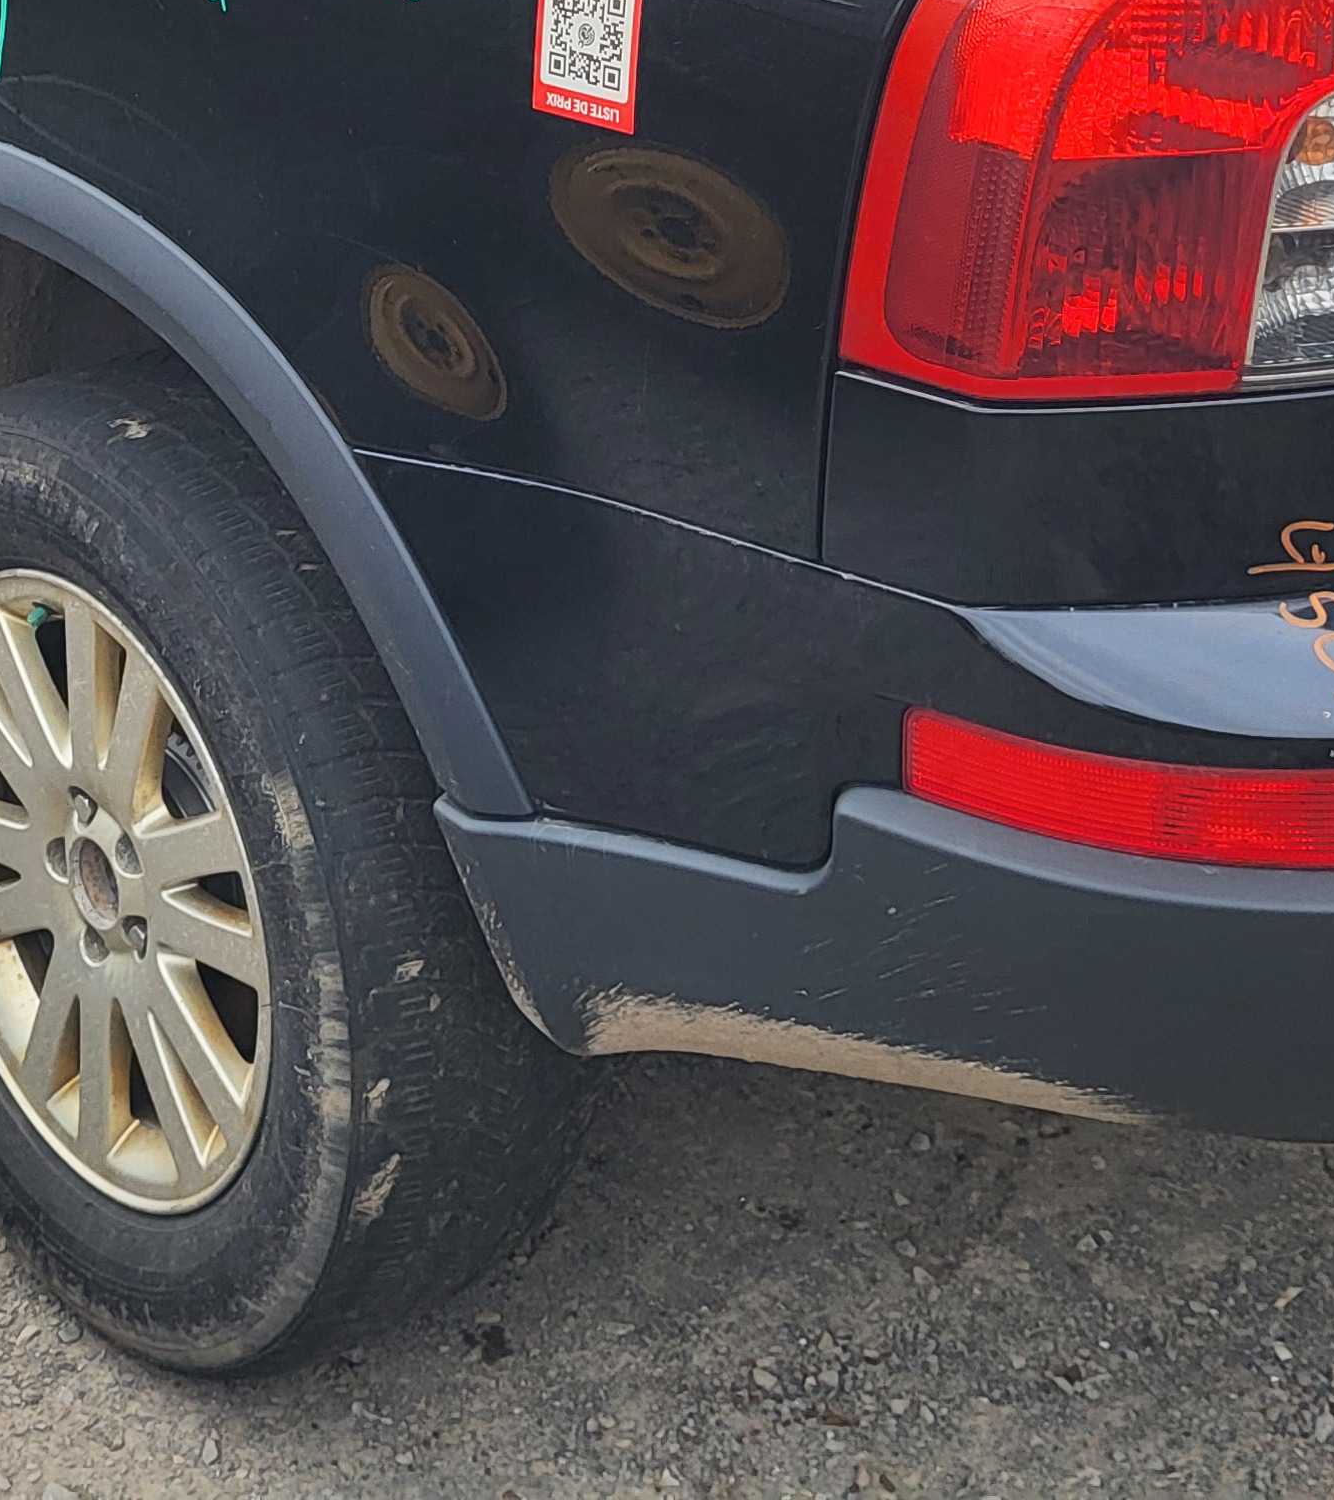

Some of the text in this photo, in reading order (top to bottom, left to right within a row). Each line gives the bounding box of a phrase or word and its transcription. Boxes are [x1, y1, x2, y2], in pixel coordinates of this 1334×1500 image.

[545, 91, 620, 124] LISTE DE PRIX
